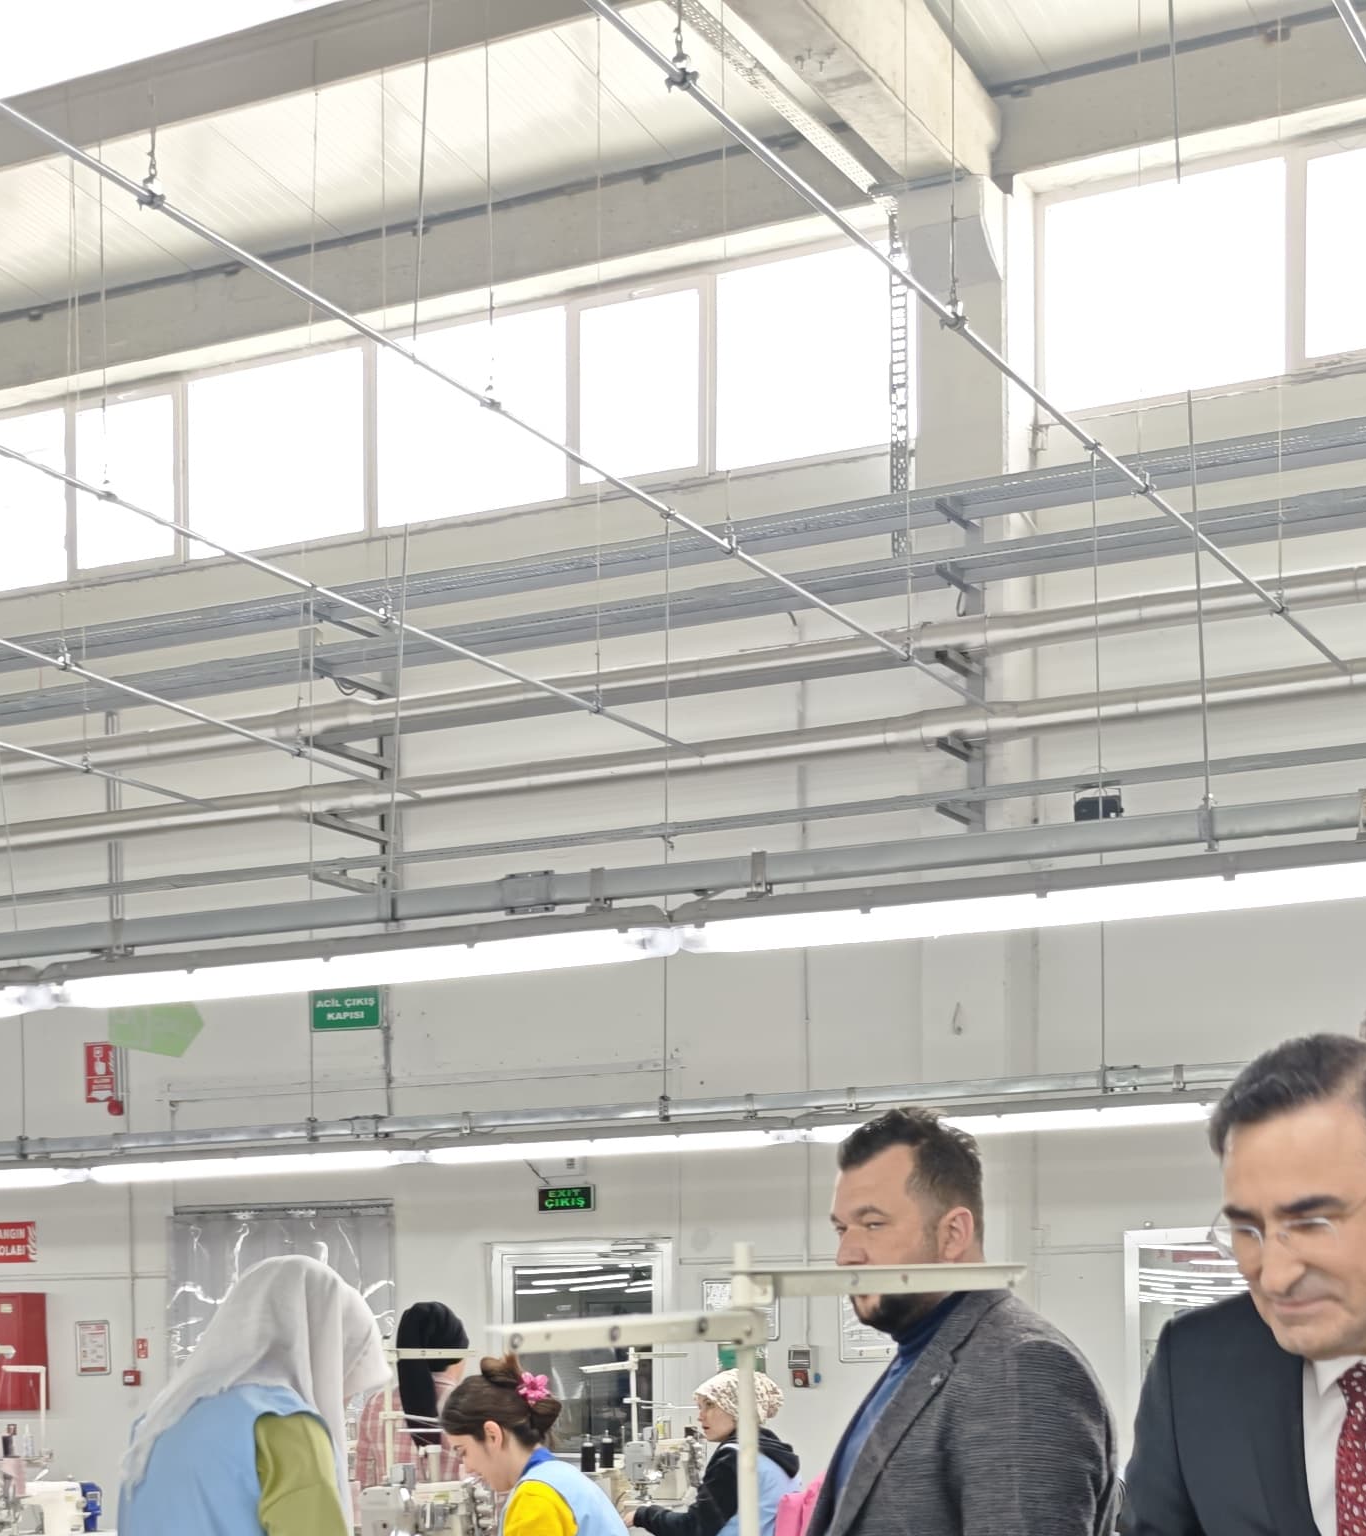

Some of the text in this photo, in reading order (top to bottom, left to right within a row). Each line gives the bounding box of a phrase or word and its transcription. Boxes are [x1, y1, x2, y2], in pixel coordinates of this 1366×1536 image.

[315, 998, 376, 1008] ACİL ÇIKIŞ
[326, 1011, 365, 1020] KAPISI
[548, 1189, 580, 1198] EXIT
[545, 1197, 585, 1209] ÇIKIŞ
